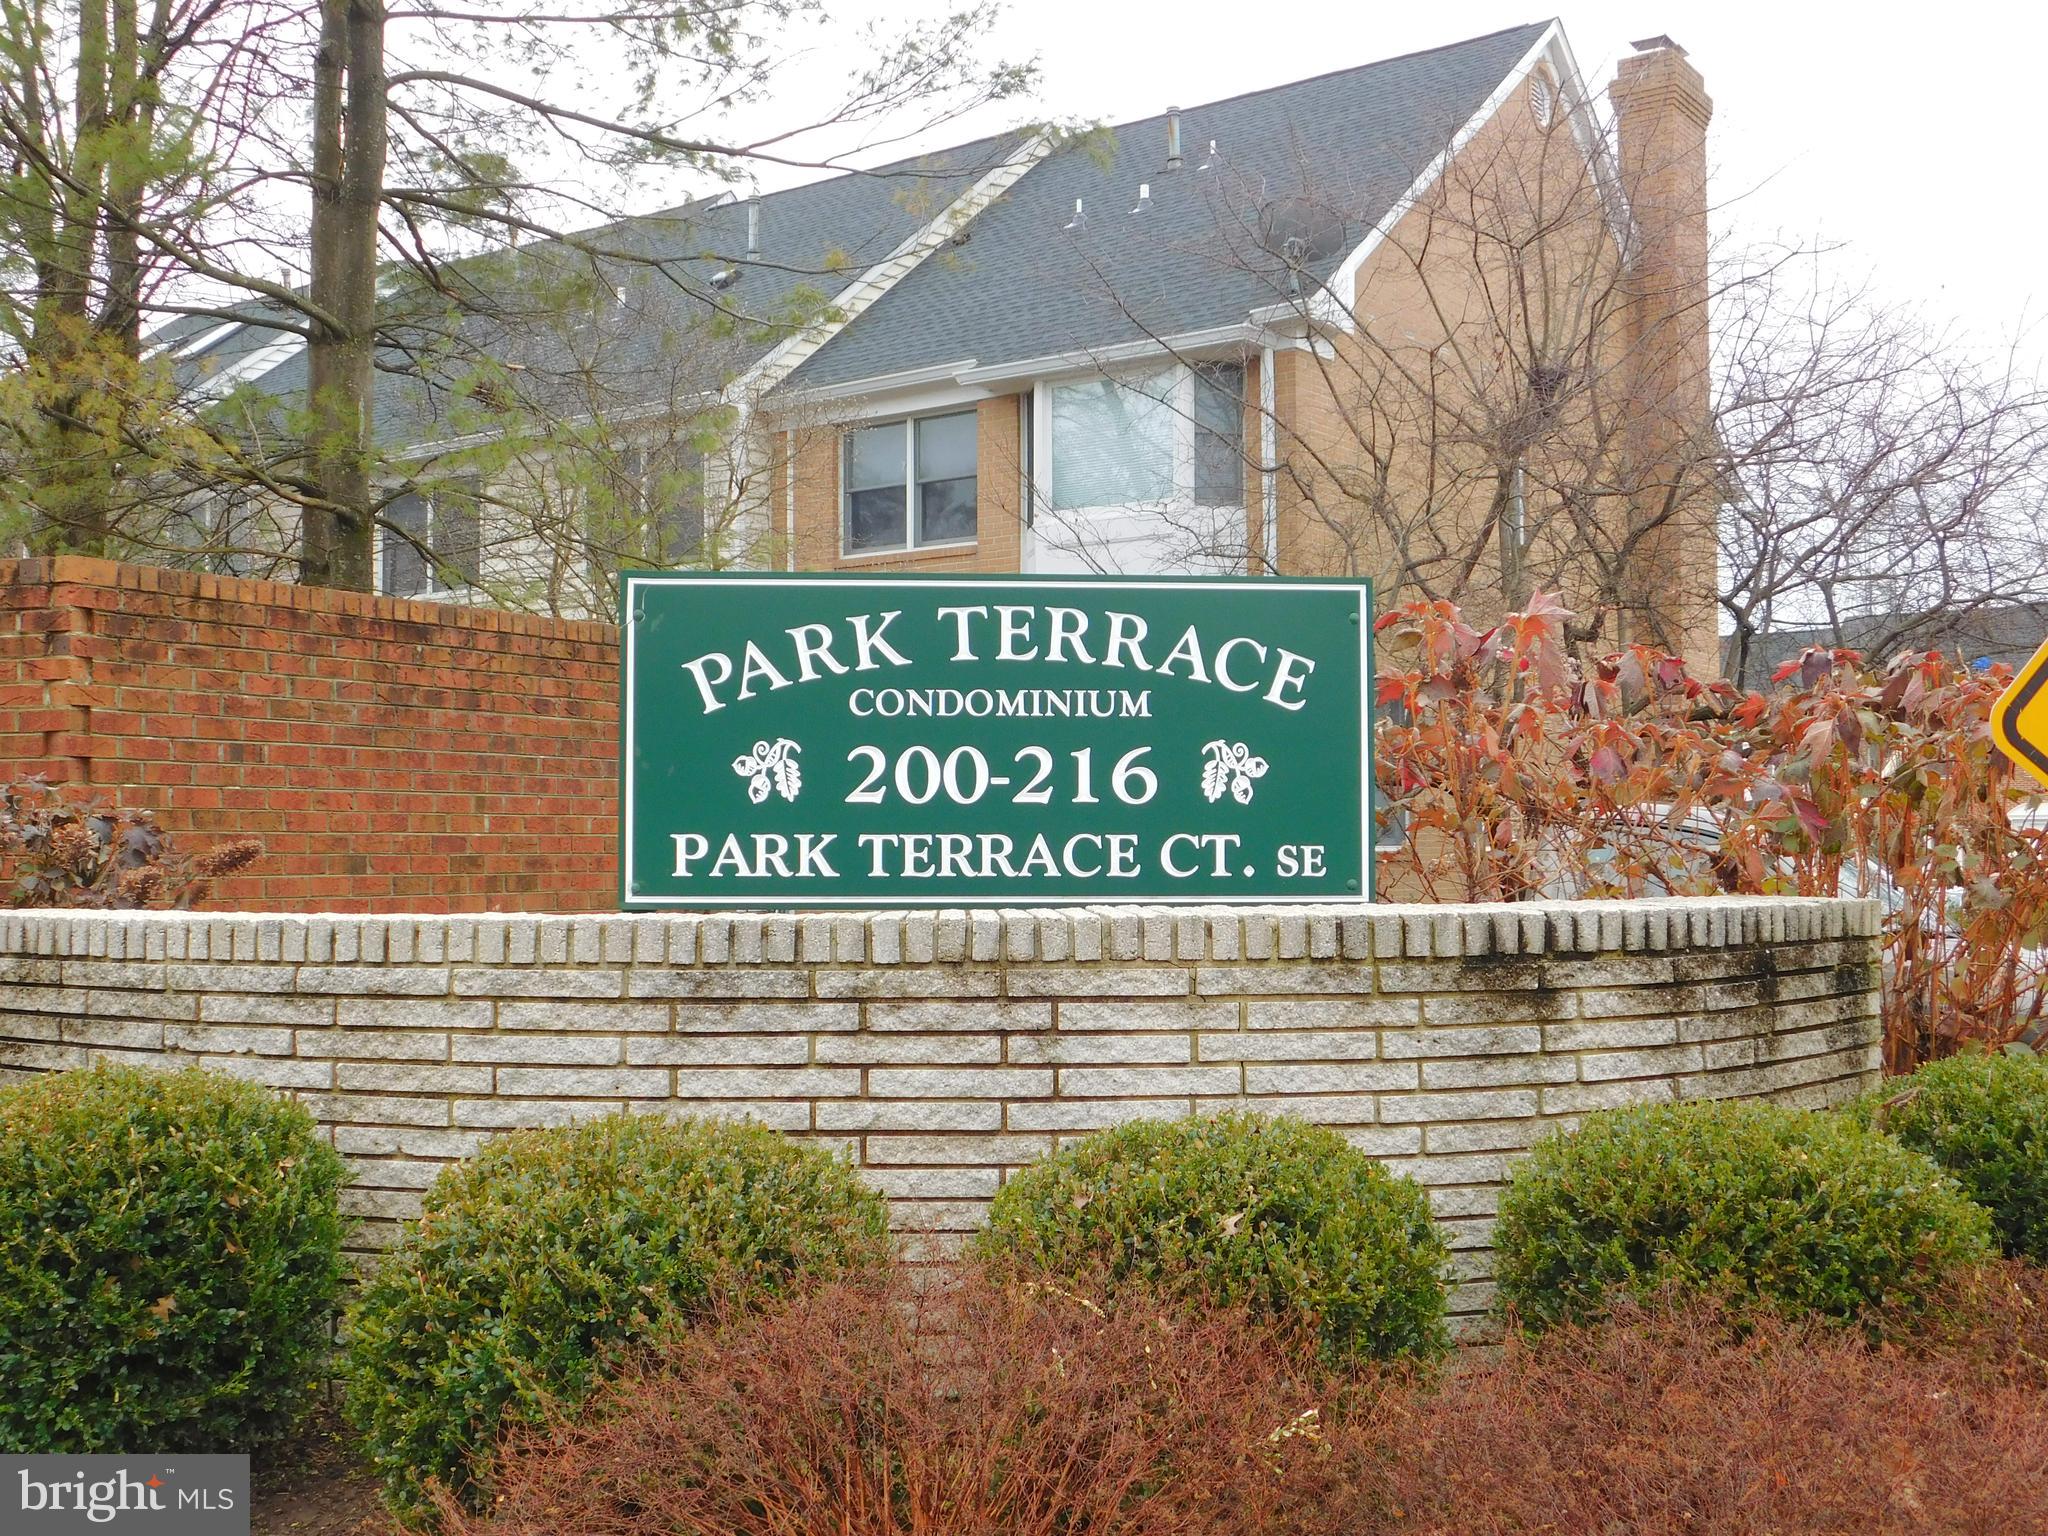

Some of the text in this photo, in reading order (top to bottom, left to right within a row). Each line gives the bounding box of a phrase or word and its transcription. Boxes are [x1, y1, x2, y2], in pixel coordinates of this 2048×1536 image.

[681, 605, 1316, 715] PARK TERRACE
[848, 688, 1153, 718] CONDOMINIUM
[844, 745, 1158, 805] 200-216
[669, 832, 1327, 878] PARK TERRACE CT. SE
